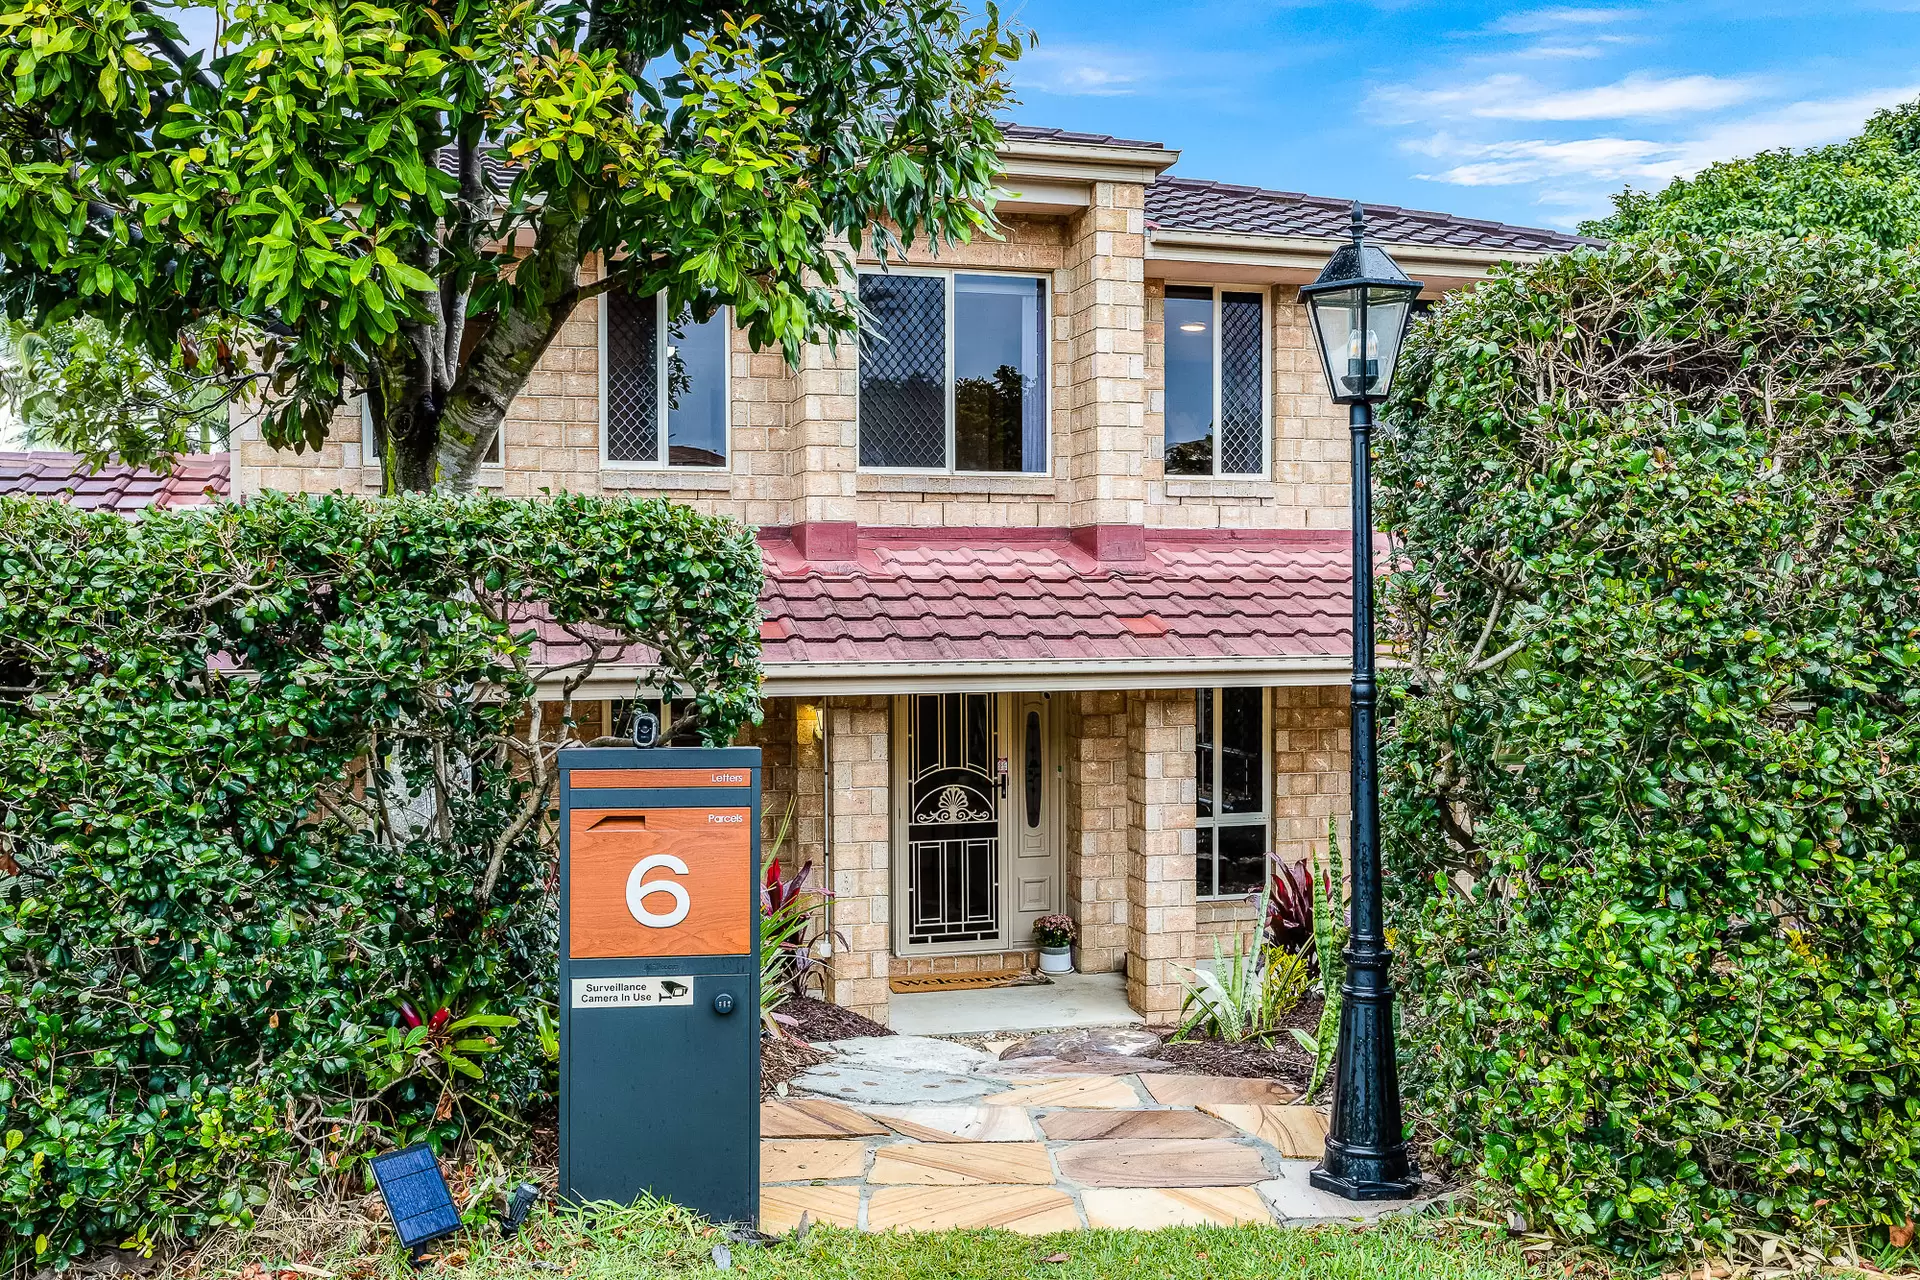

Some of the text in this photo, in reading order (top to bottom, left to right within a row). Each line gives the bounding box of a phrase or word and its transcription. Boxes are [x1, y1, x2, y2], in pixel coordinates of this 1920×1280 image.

[711, 773, 743, 783] Letters
[708, 814, 743, 823] Parcels
[625, 853, 691, 929] 6
[586, 983, 647, 992] Surveillance
[581, 993, 652, 1003] Camera In Use
